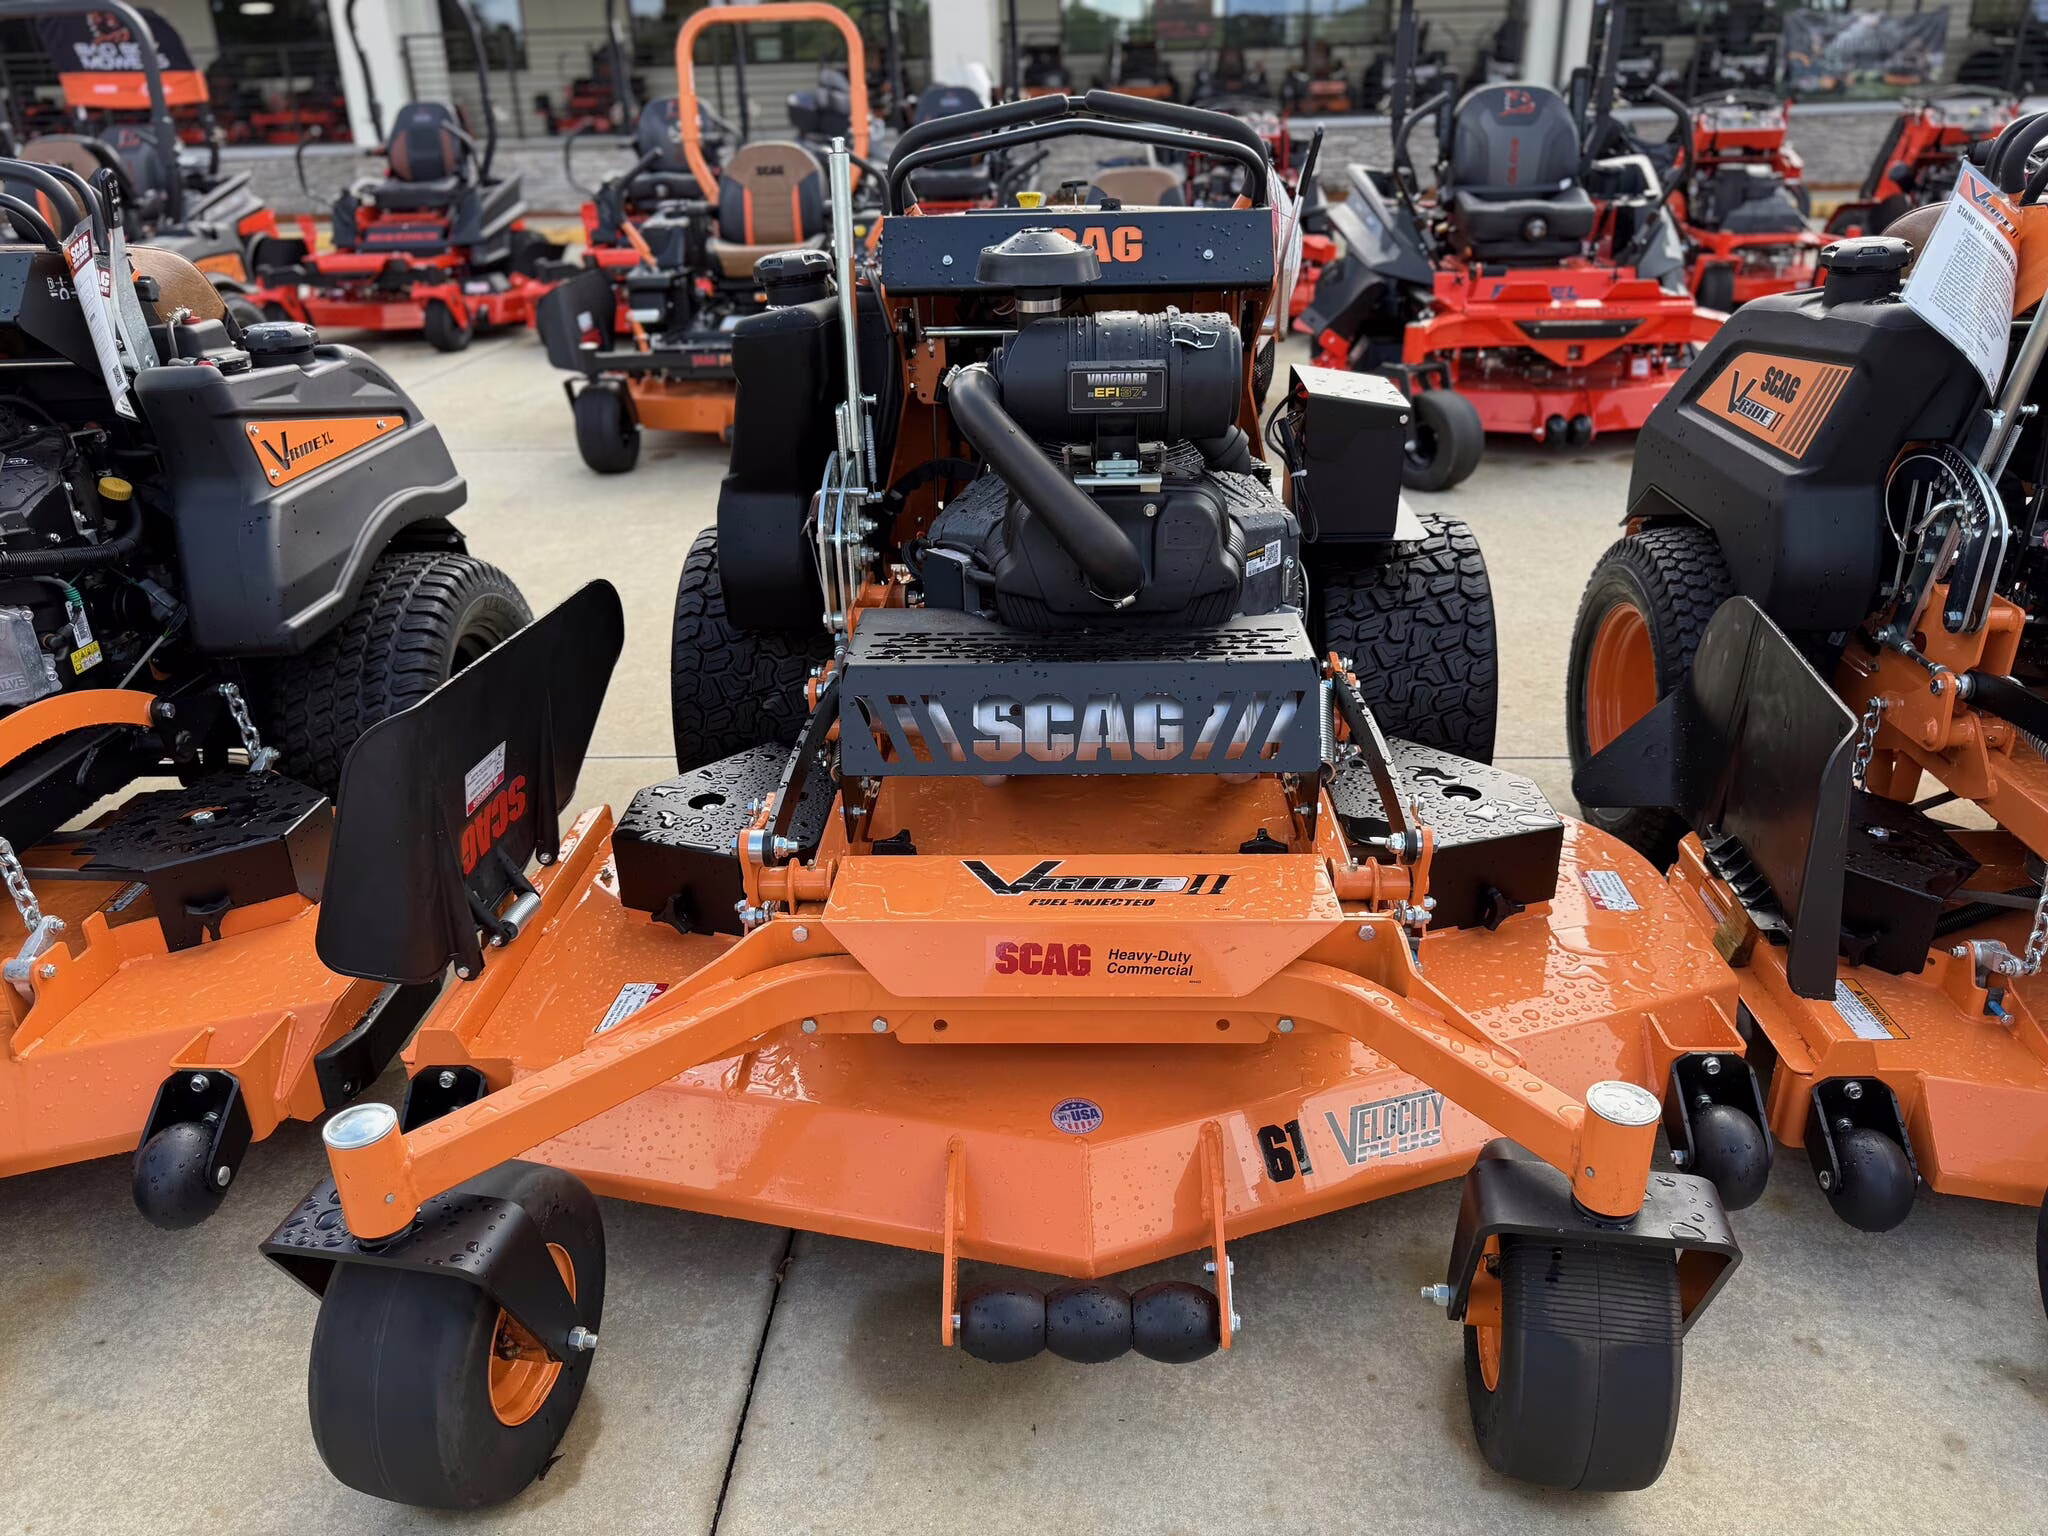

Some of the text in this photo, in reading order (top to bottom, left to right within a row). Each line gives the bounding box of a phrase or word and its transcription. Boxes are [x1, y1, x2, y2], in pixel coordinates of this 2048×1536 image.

[70, 236, 89, 263] SCAG
[1956, 205, 1976, 226] STAND
[1975, 221, 1984, 232] UP
[1993, 239, 2011, 263] HIGHER
[1087, 373, 1147, 386] VANGUARD
[1761, 366, 1801, 404] SCAG
[322, 431, 334, 446] XL
[972, 692, 1184, 762] SCAG
[461, 774, 526, 876] SCAG
[1028, 898, 1156, 907] FUEL-INJECTED
[995, 942, 1091, 976] SCAG
[1106, 962, 1194, 977] Commercial
[1108, 948, 1192, 965] Heavy-Duty
[1860, 995, 1893, 1027] WARNING
[1070, 1107, 1100, 1121] USA
[1324, 1088, 1446, 1165] VELOCITY
[1257, 1119, 1314, 1182] 61
[1357, 1129, 1442, 1163] PLUS
